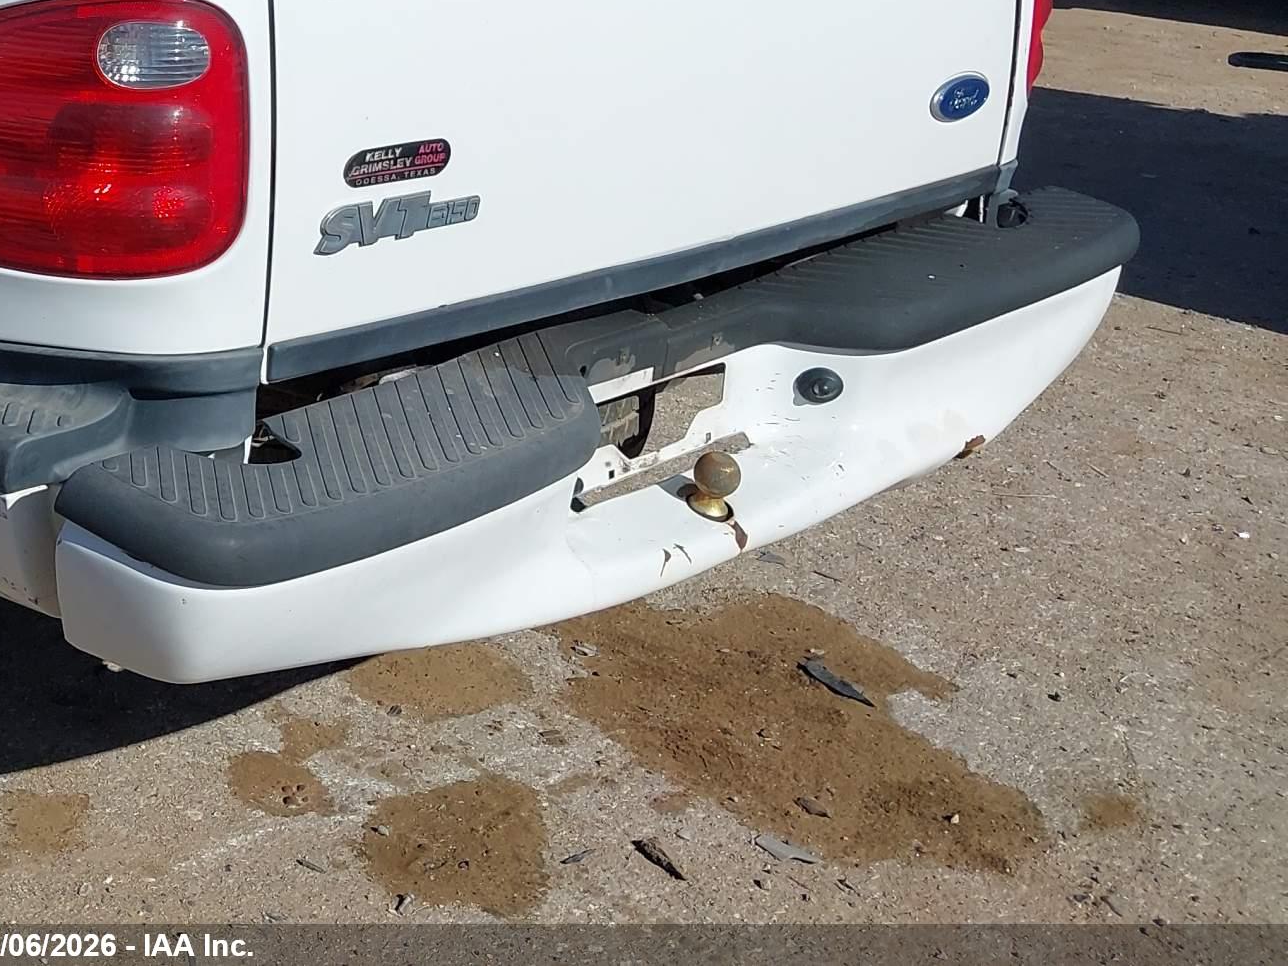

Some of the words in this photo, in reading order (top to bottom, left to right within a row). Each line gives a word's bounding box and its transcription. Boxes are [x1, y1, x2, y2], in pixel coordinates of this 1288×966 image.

[418, 142, 444, 154] AUTO
[365, 147, 402, 162] KELLY
[414, 153, 446, 165] GROUP
[349, 156, 412, 177] GRIMSLEY
[405, 167, 436, 178] TEXAS
